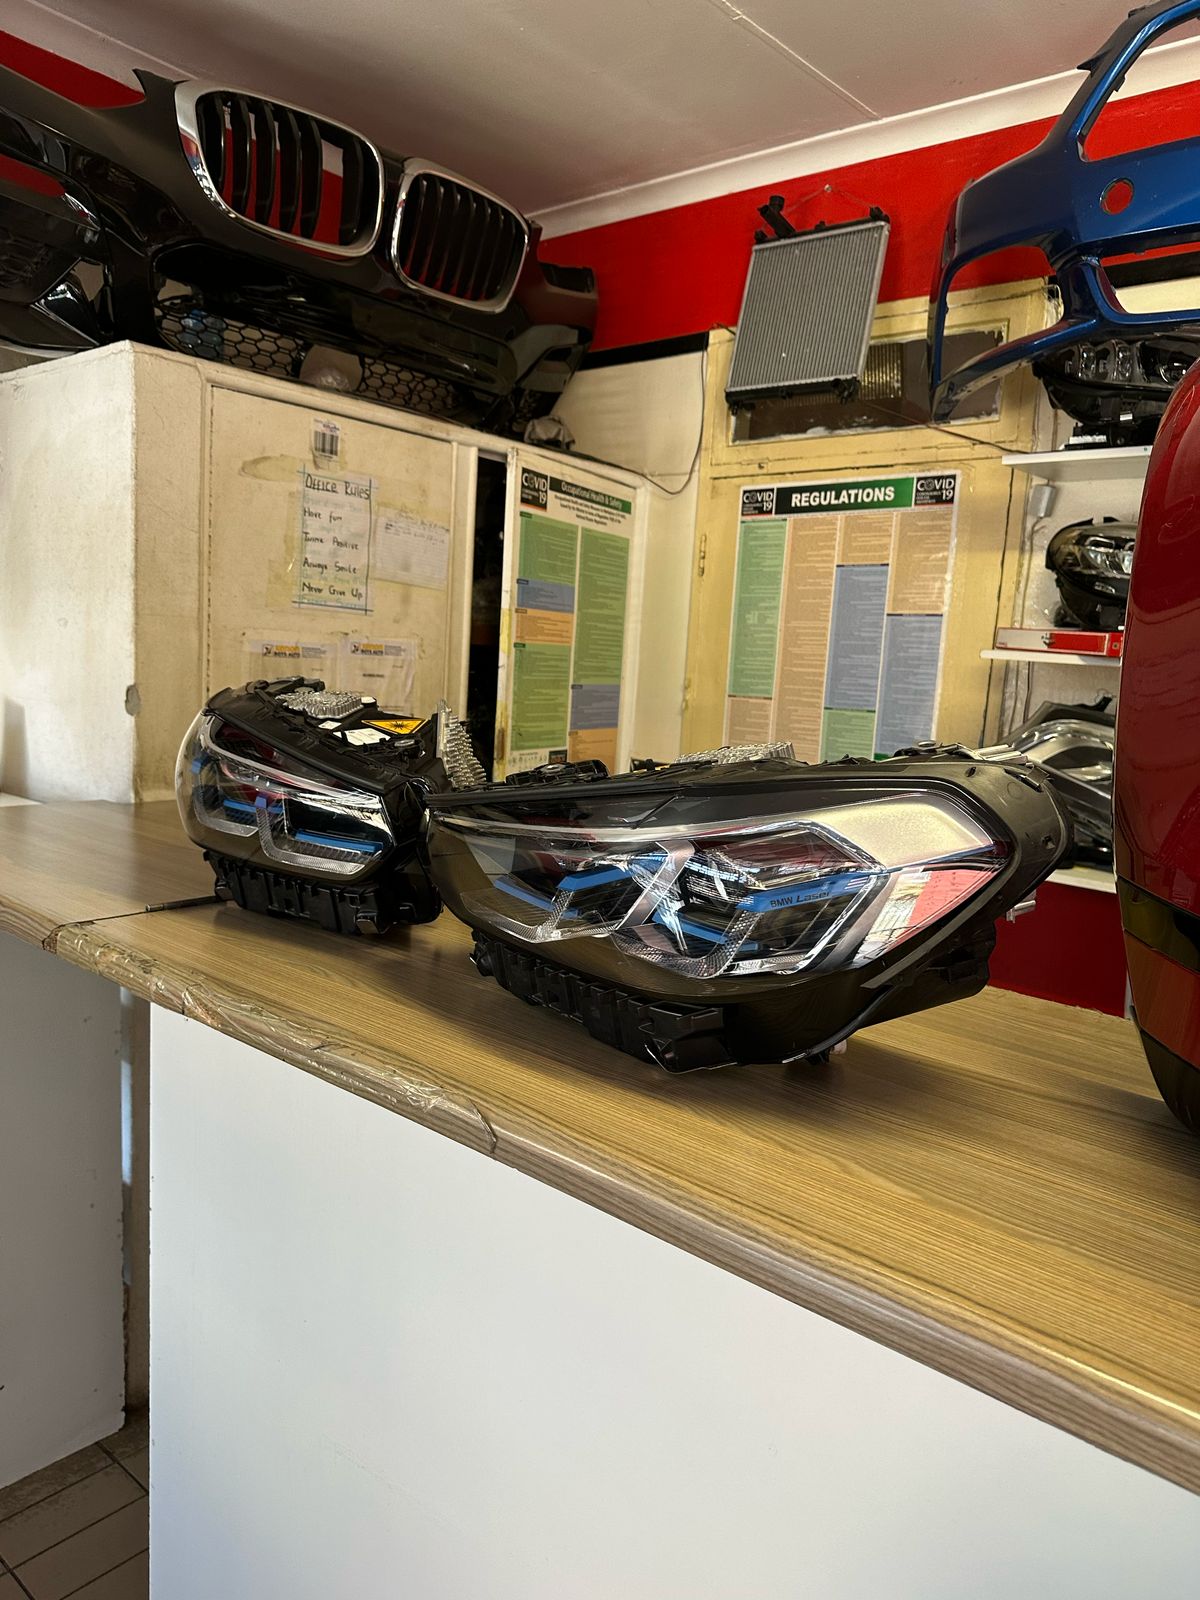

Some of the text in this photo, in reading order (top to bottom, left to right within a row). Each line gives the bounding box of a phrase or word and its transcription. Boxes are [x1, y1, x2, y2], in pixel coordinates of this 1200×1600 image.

[522, 472, 547, 492] COVID
[917, 478, 955, 491] COVID
[344, 481, 370, 500] Rules
[743, 491, 773, 503] COVID
[791, 486, 895, 508] REGULATIONS
[941, 489, 953, 500] 19
[539, 491, 547, 504] 19
[763, 501, 773, 511] 19
[335, 561, 357, 574] Smile
[351, 588, 363, 600] Up
[770, 891, 830, 908] BMW Laser
